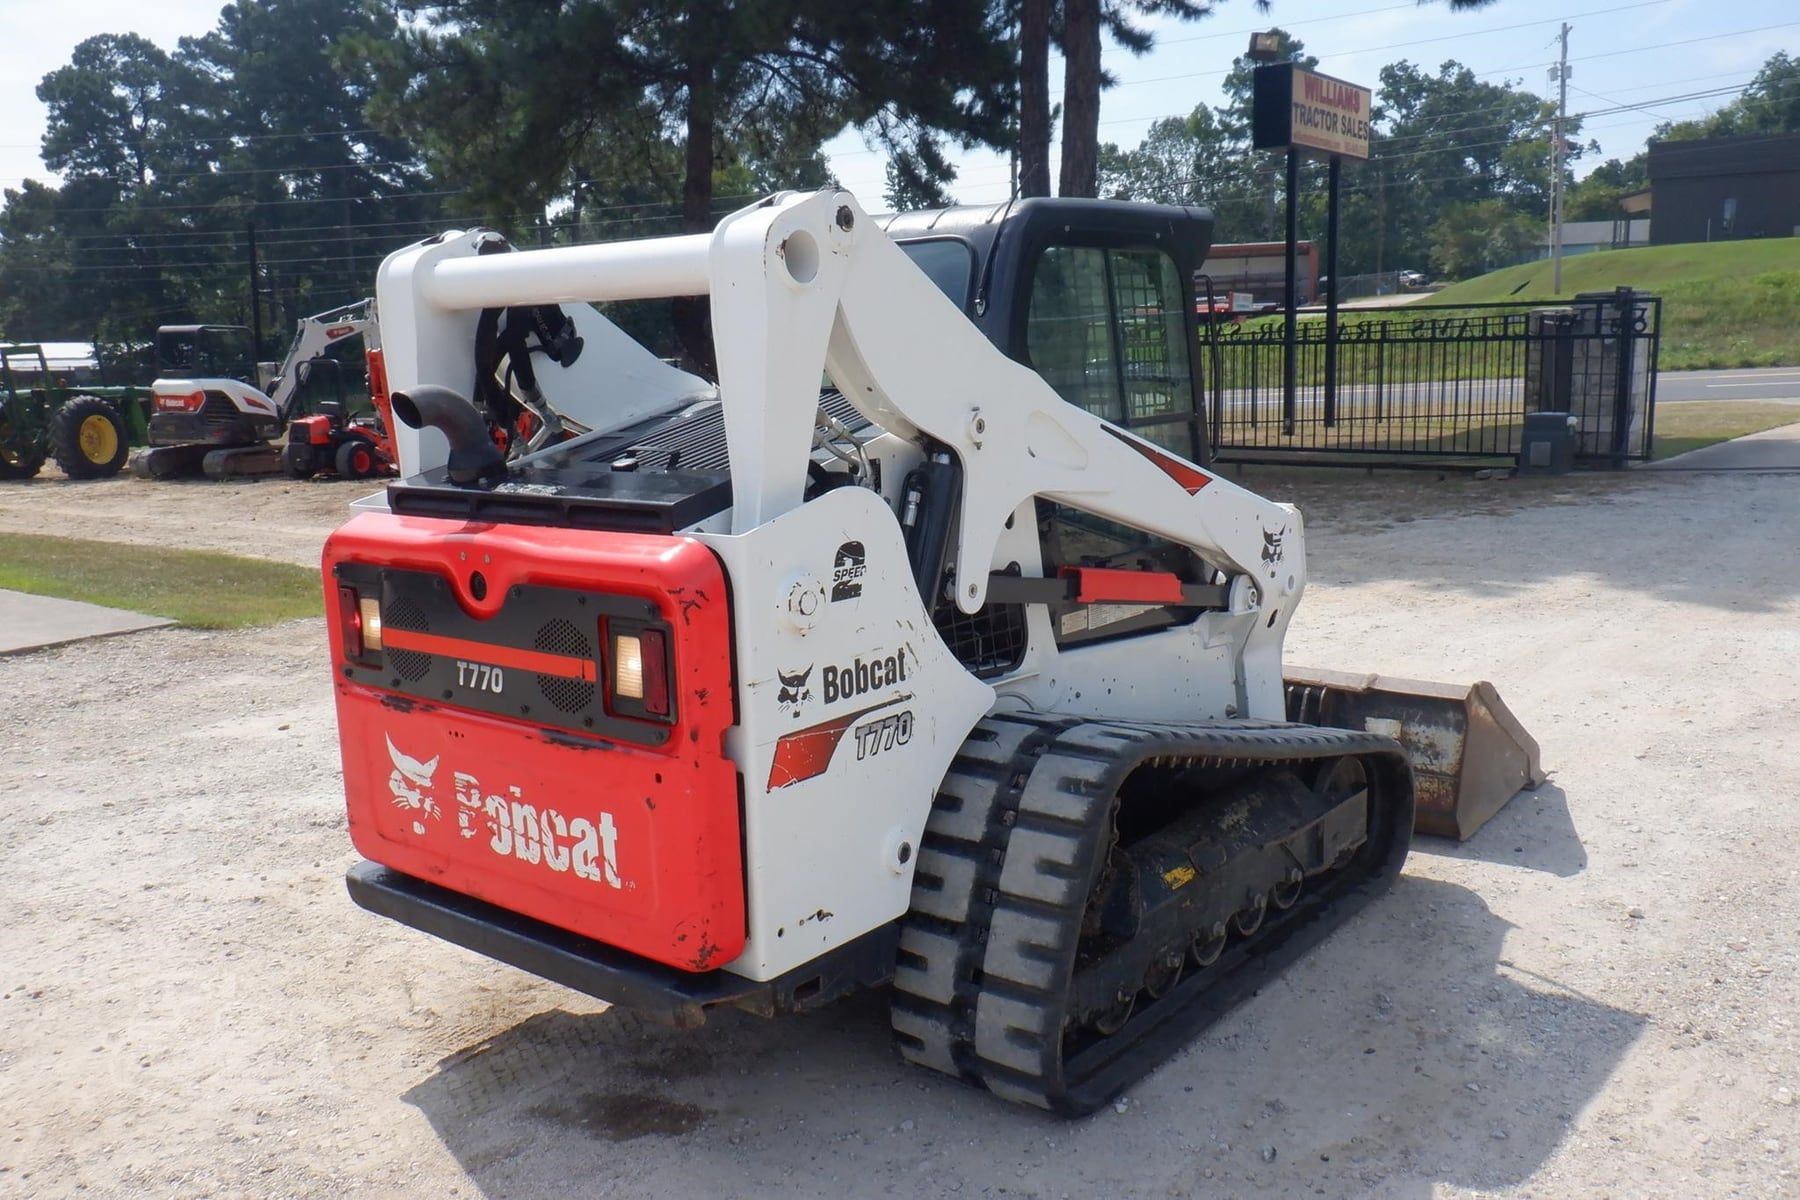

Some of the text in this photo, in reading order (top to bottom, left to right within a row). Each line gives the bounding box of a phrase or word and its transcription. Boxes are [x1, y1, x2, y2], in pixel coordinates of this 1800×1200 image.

[1304, 73, 1360, 114] WILLIAMS
[1293, 102, 1368, 140] TRACTOR SALES
[457, 660, 503, 693] T770
[822, 648, 906, 705] Bobcat
[855, 710, 913, 760] T770
[454, 771, 622, 888] Bobcat
